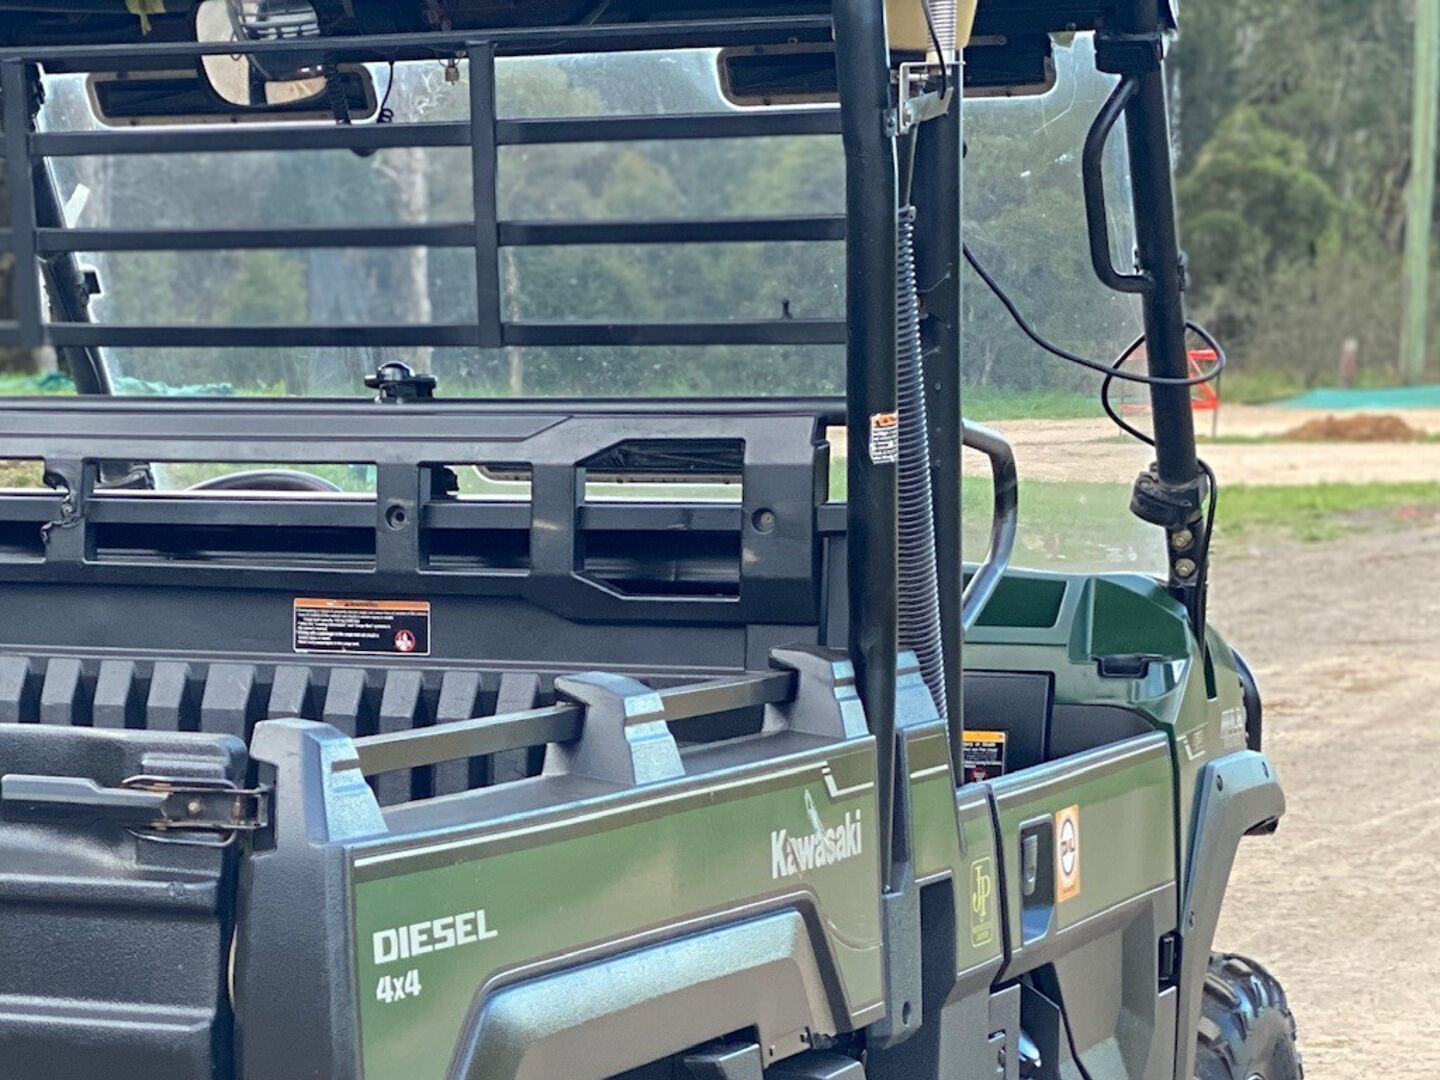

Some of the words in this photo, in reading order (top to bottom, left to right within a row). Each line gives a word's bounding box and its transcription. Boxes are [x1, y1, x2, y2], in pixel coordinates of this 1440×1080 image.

[771, 810, 863, 879] Kawasaki
[373, 909, 498, 965] DIESEL
[376, 969, 422, 1004] 4x4
